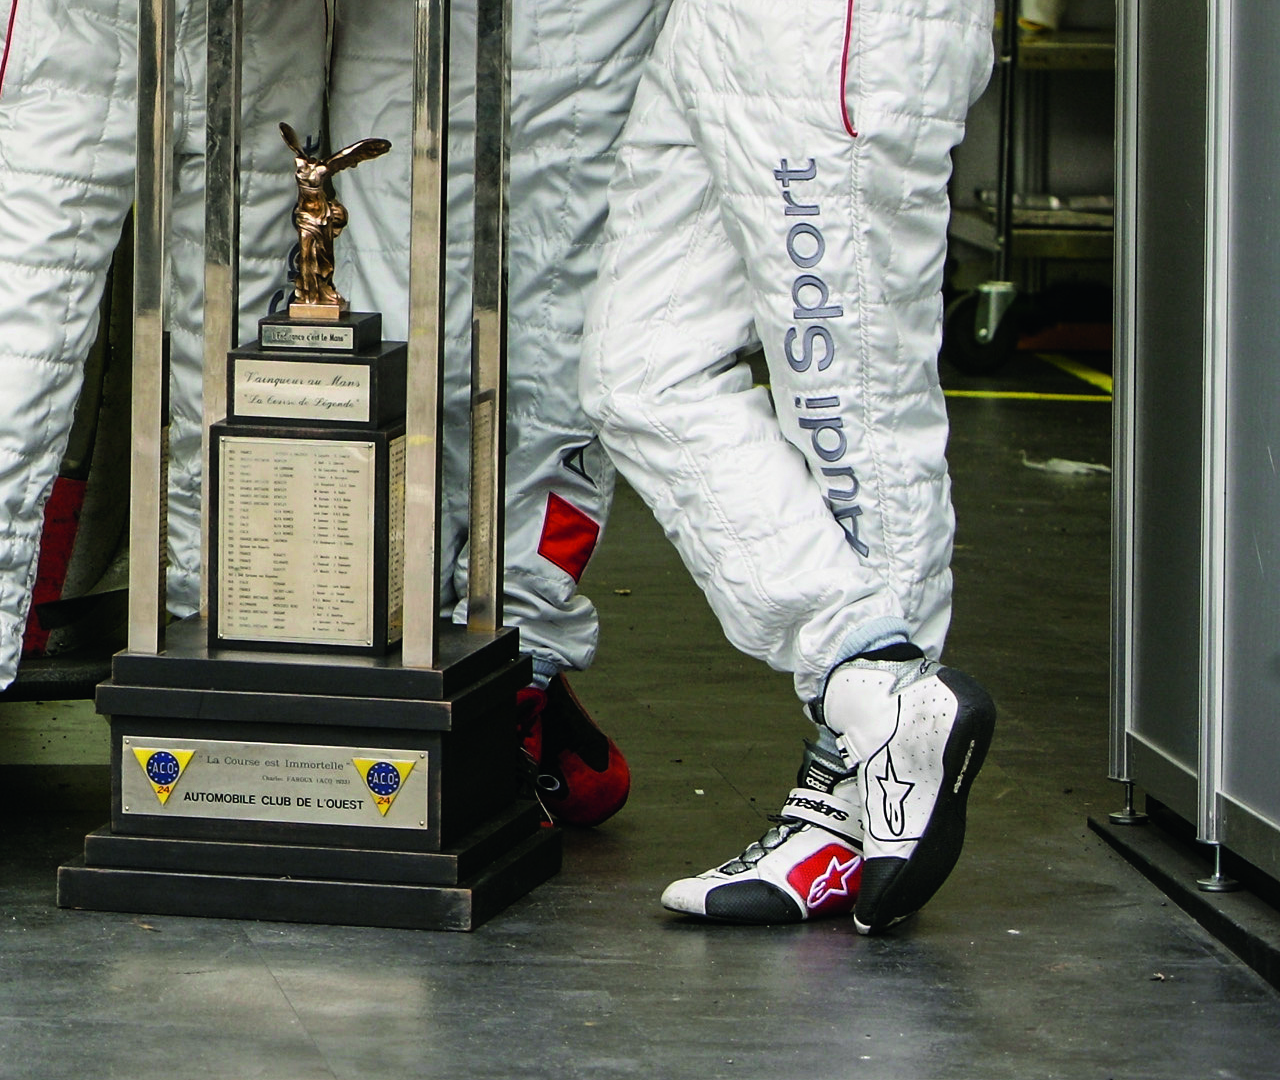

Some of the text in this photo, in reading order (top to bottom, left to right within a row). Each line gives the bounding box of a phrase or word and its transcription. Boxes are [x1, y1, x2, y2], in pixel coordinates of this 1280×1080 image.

[774, 157, 844, 373] Sport
[153, 762, 174, 774] ACO
[224, 756, 260, 767] Course
[265, 759, 279, 767] est
[285, 759, 344, 770] Immortelle
[372, 772, 395, 785] ACO
[157, 785, 170, 794] 24
[183, 792, 364, 810] AUTOMOBILE CLUB DE L'OUEST
[377, 796, 391, 805] 24
